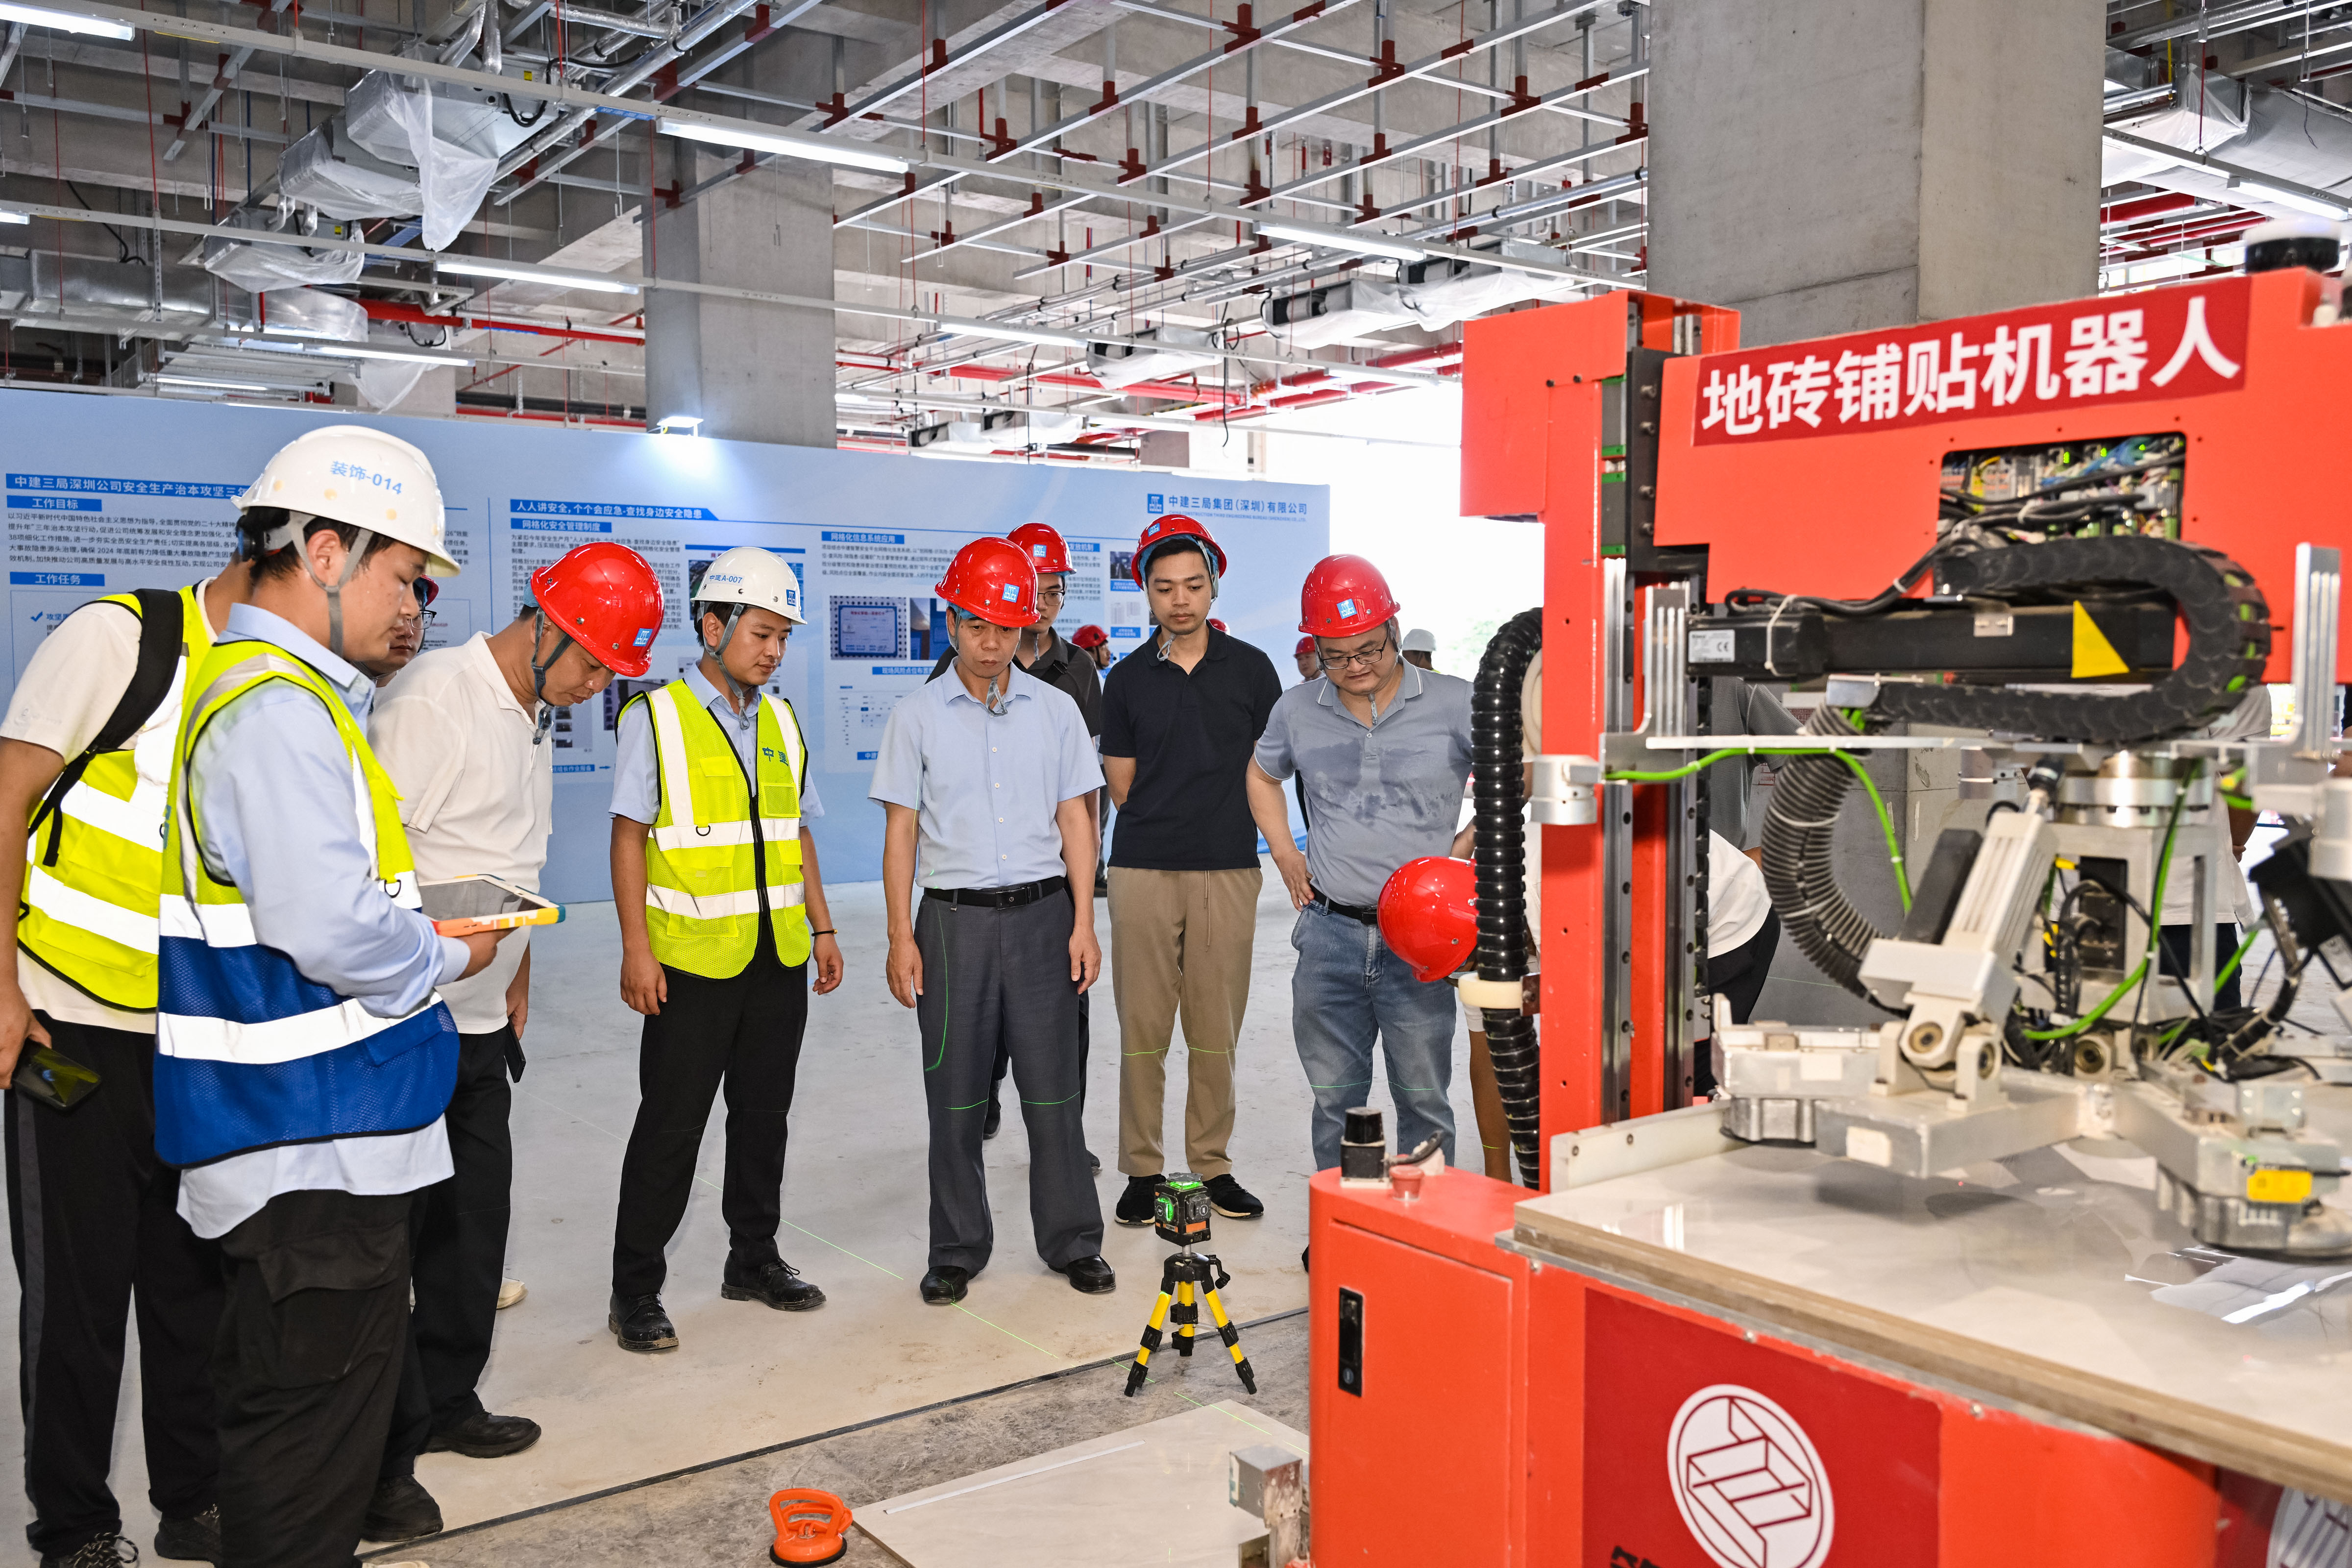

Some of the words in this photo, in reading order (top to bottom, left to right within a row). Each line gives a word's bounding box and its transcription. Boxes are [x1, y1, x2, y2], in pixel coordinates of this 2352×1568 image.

[1700, 295, 2241, 436] 地砖铺贴机器人
[330, 460, 402, 495] 装饰-014
[32, 498, 78, 510] 工作目标
[522, 519, 601, 533] 网格化安全管理制度
[35, 574, 80, 585] 工作任务
